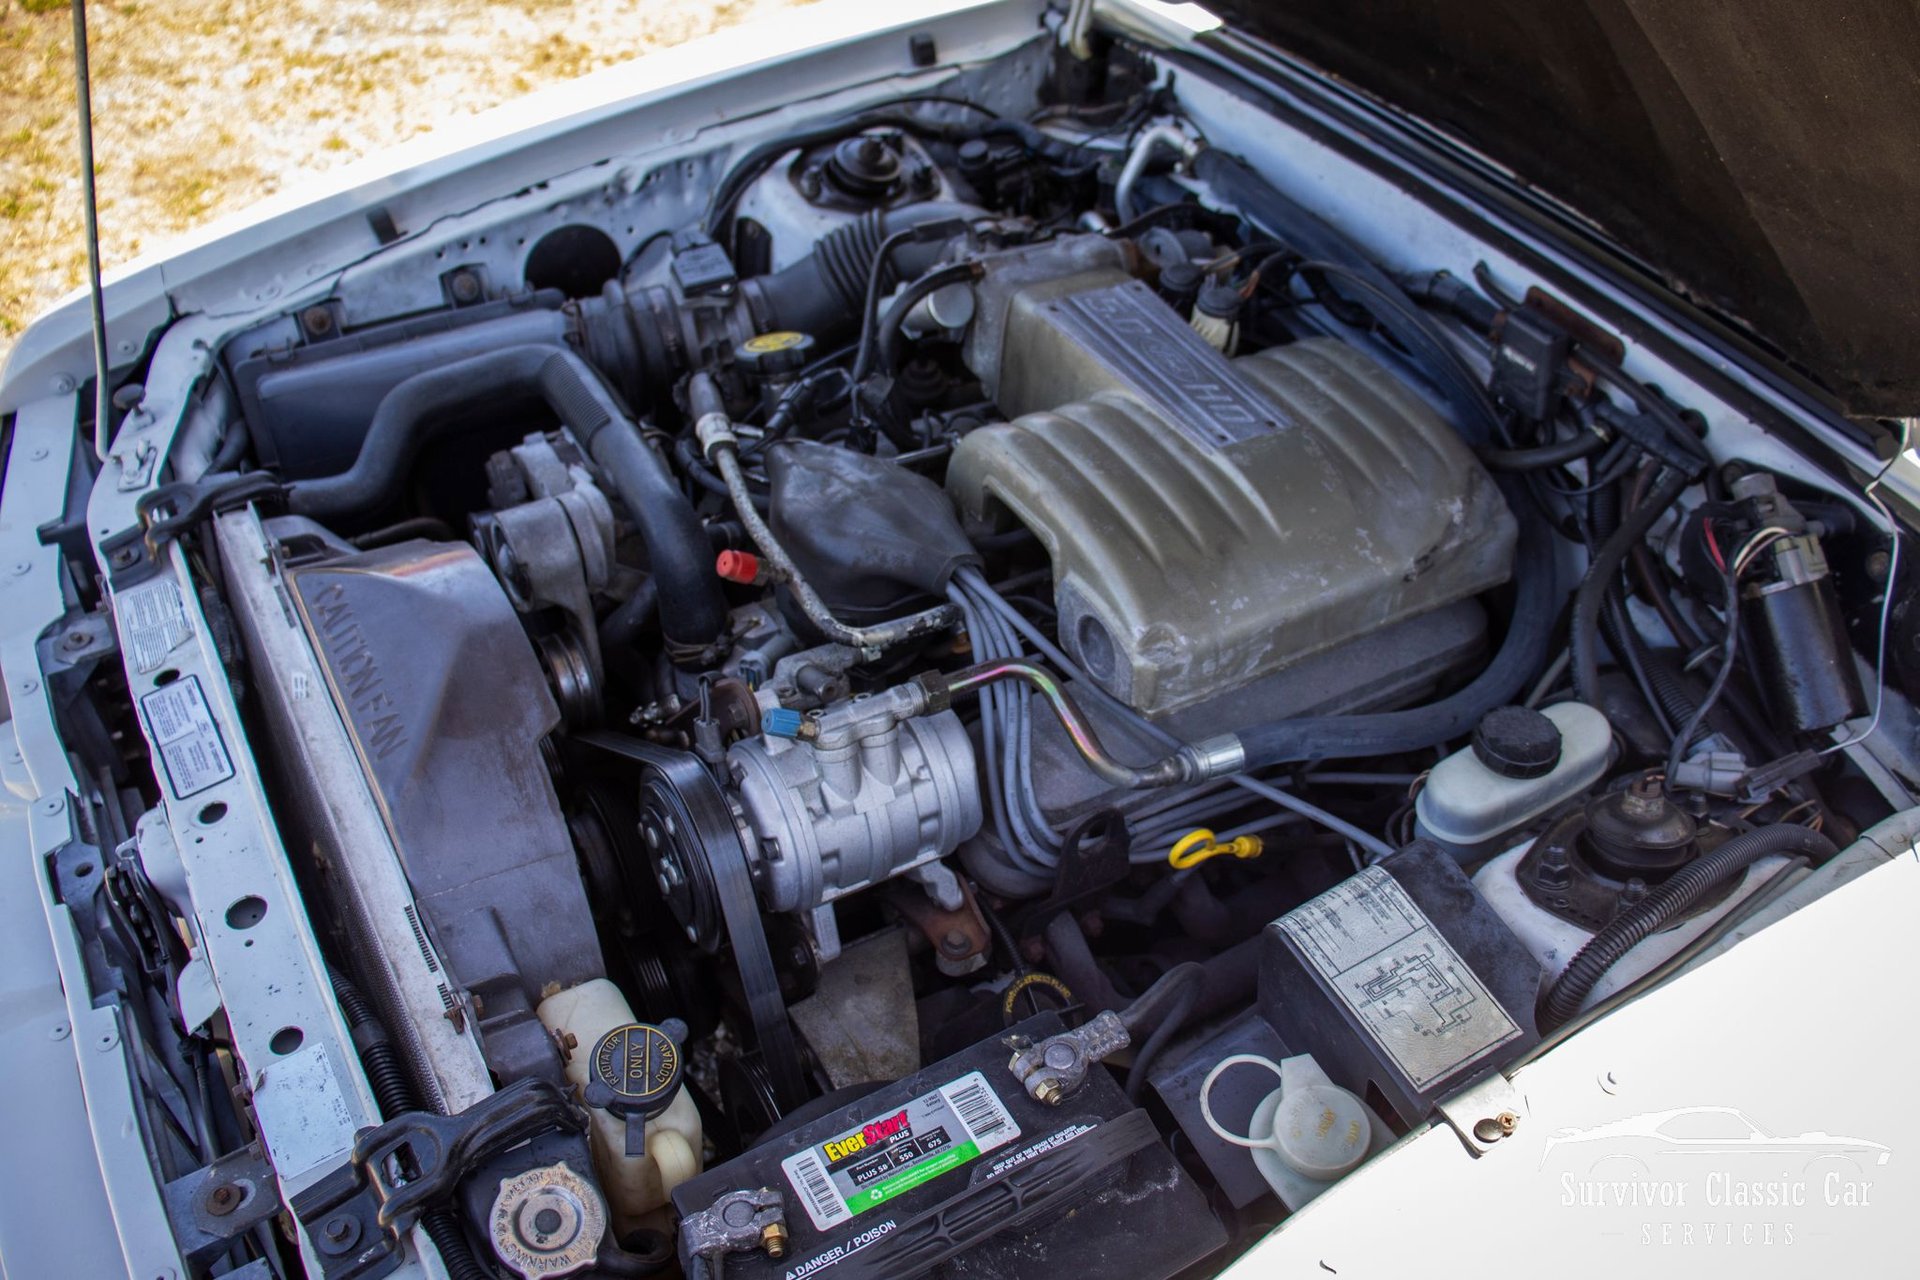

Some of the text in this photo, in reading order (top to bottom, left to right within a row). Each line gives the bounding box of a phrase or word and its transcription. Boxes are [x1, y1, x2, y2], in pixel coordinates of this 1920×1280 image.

[313, 583, 408, 761] CAUTION FAN
[601, 1036, 621, 1085] RADIATOR
[630, 1043, 643, 1079] ONLY
[655, 1039, 674, 1083] COOLANT
[823, 1109, 910, 1162] EverStart
[889, 1129, 910, 1143] PLUS
[927, 1137, 942, 1149] 675
[857, 1168, 878, 1182] PLUS
[899, 1151, 914, 1162] 550
[795, 1246, 843, 1276] DANGER
[853, 1220, 896, 1247] POISON
